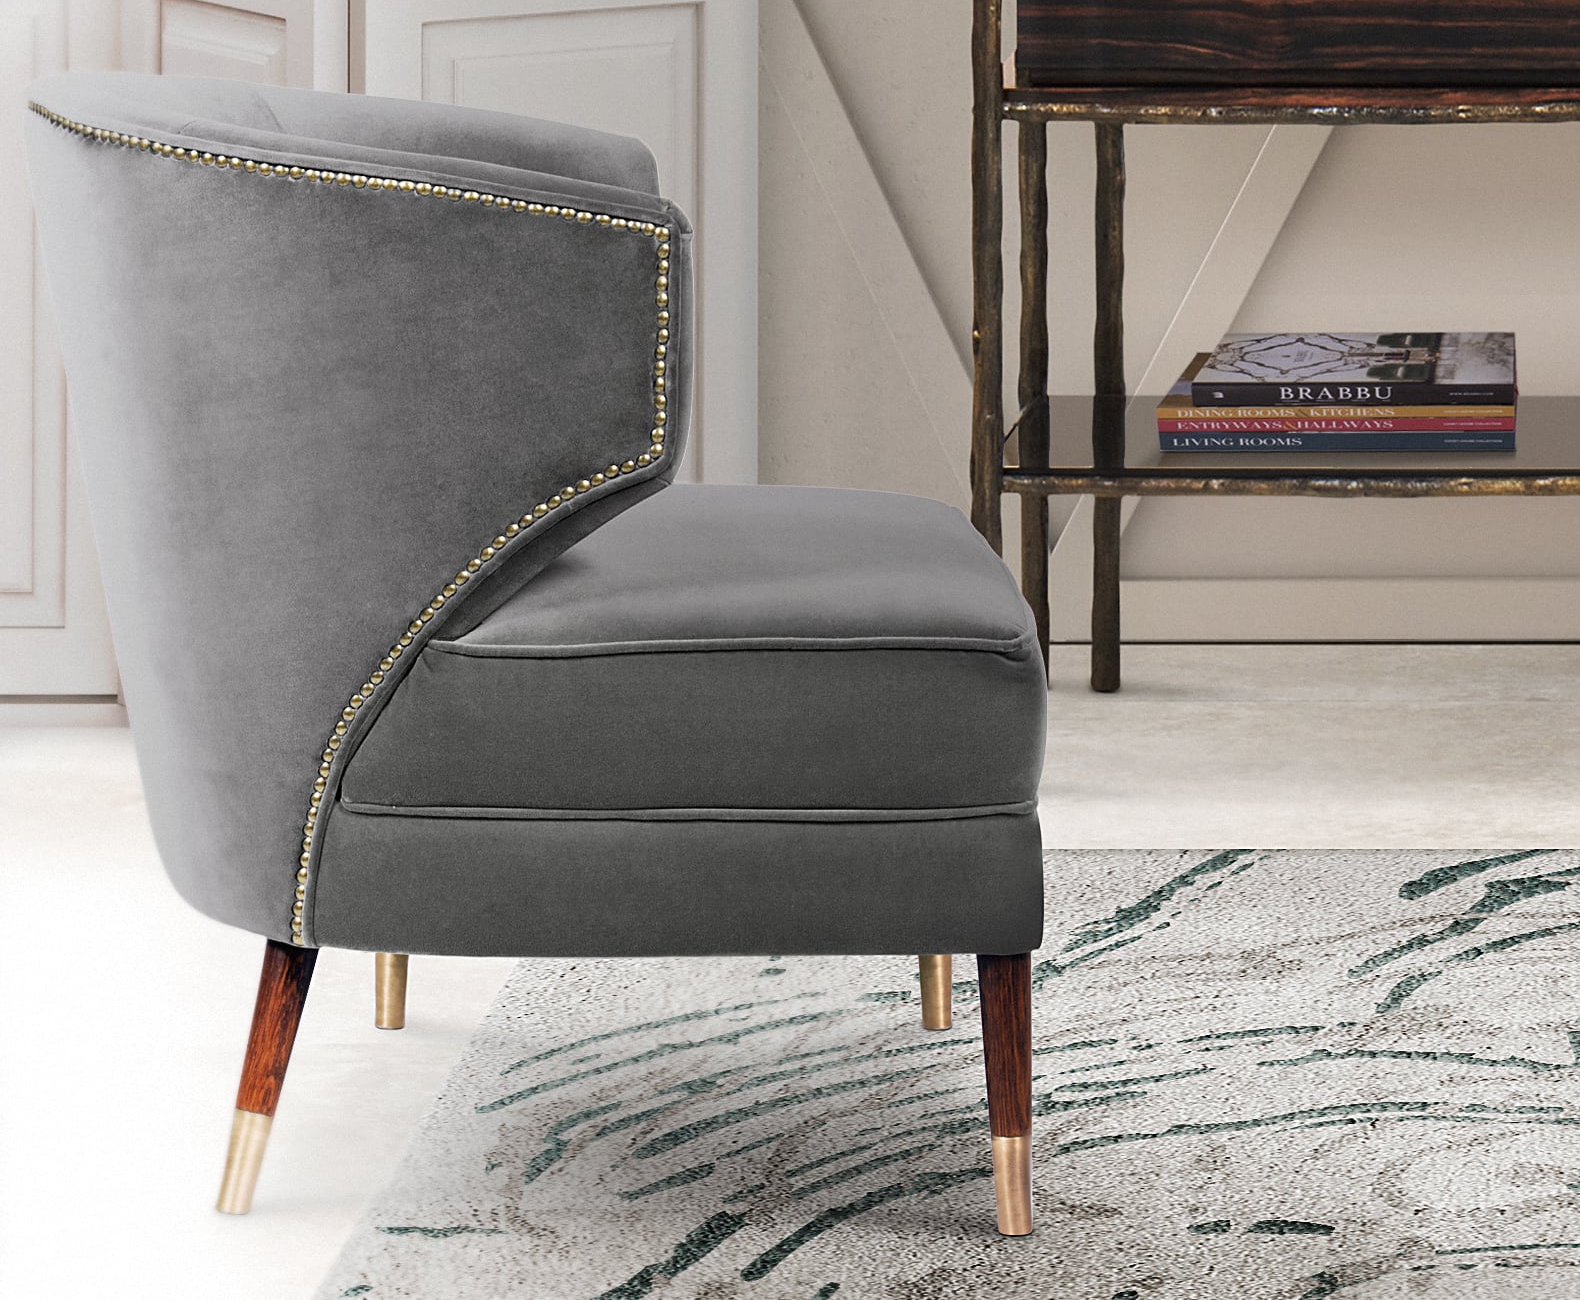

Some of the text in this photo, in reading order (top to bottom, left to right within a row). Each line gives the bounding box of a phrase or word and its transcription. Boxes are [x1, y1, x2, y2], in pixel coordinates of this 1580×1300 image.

[1280, 386, 1392, 400] BRABBU
[1177, 409, 1233, 418] DINING
[1238, 408, 1295, 417] ROOMS
[1309, 408, 1395, 417] KITCHENS
[1177, 421, 1282, 430] ENTRYWAYS
[1297, 420, 1393, 429] HALLWAYS
[1173, 438, 1302, 447] LIVING ROOMS
